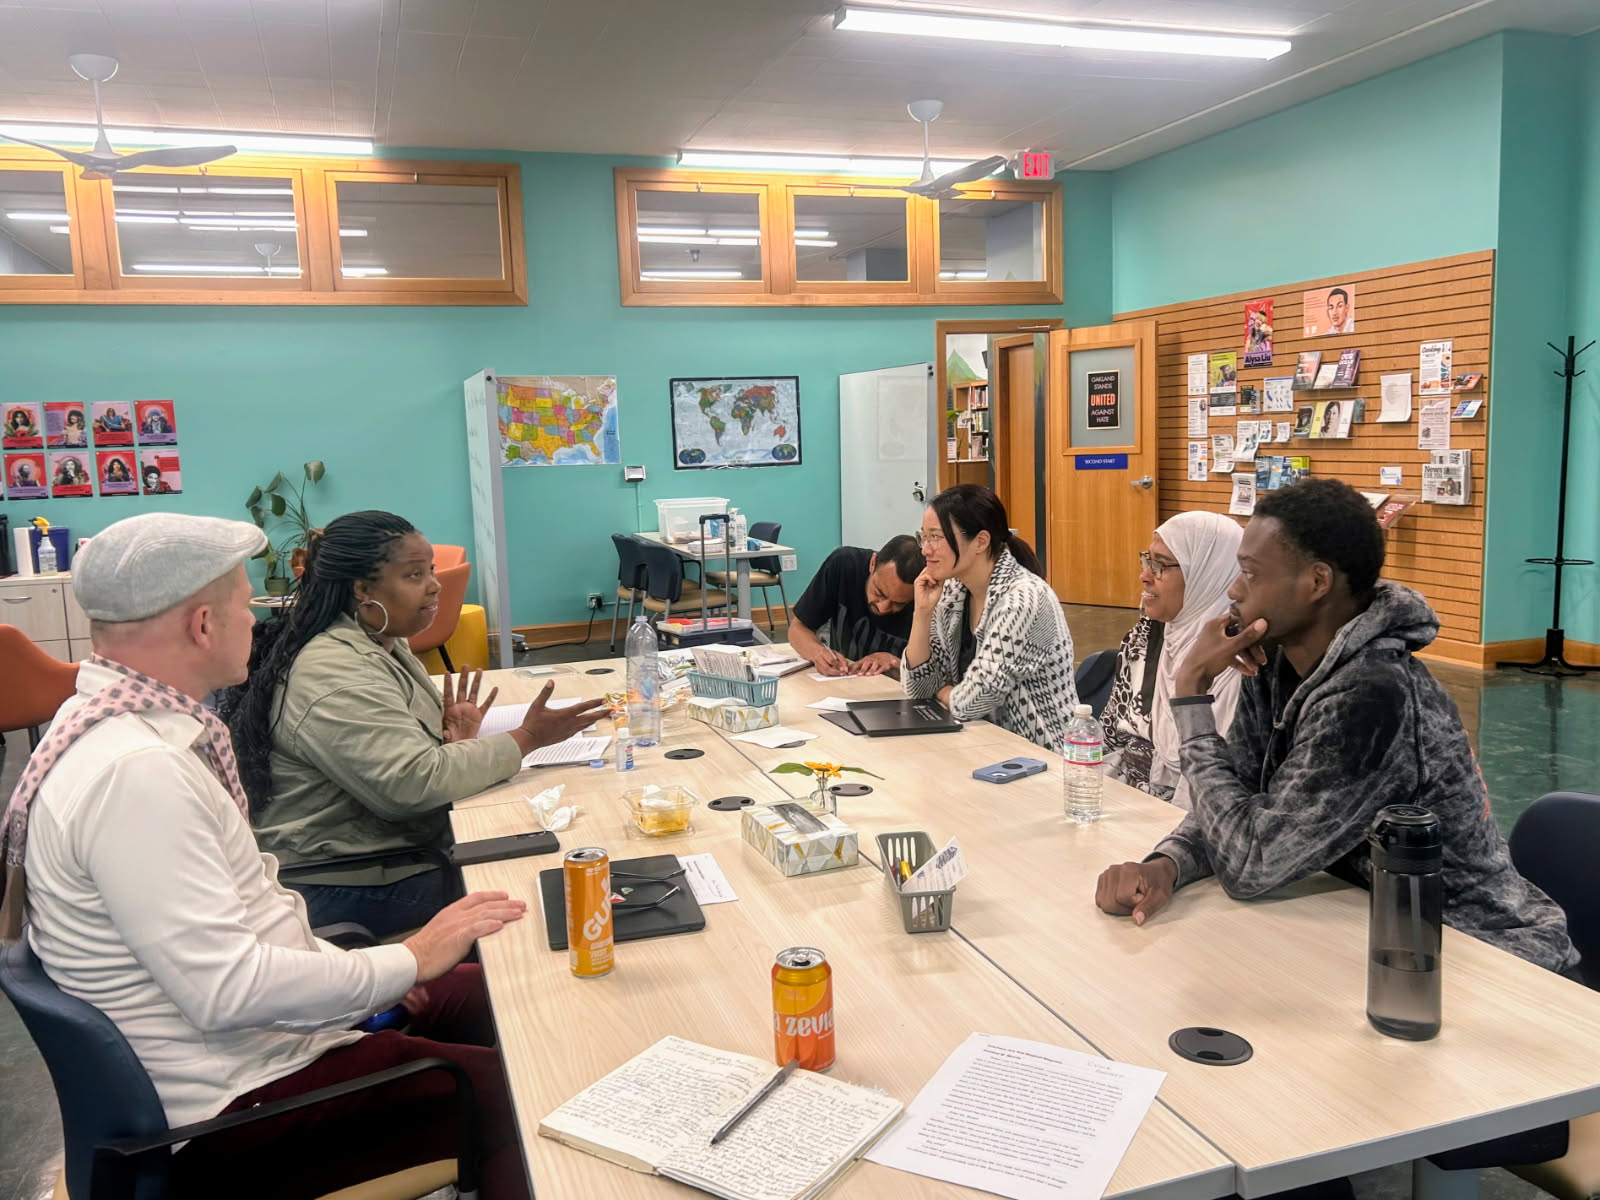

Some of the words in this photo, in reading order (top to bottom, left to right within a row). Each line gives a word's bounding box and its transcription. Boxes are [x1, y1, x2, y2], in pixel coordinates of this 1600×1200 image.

[1023, 152, 1050, 177] EXIT
[1091, 375, 1115, 383] OAKLAND
[1090, 393, 1116, 406] UNITED
[1091, 408, 1114, 416] AGAINST
